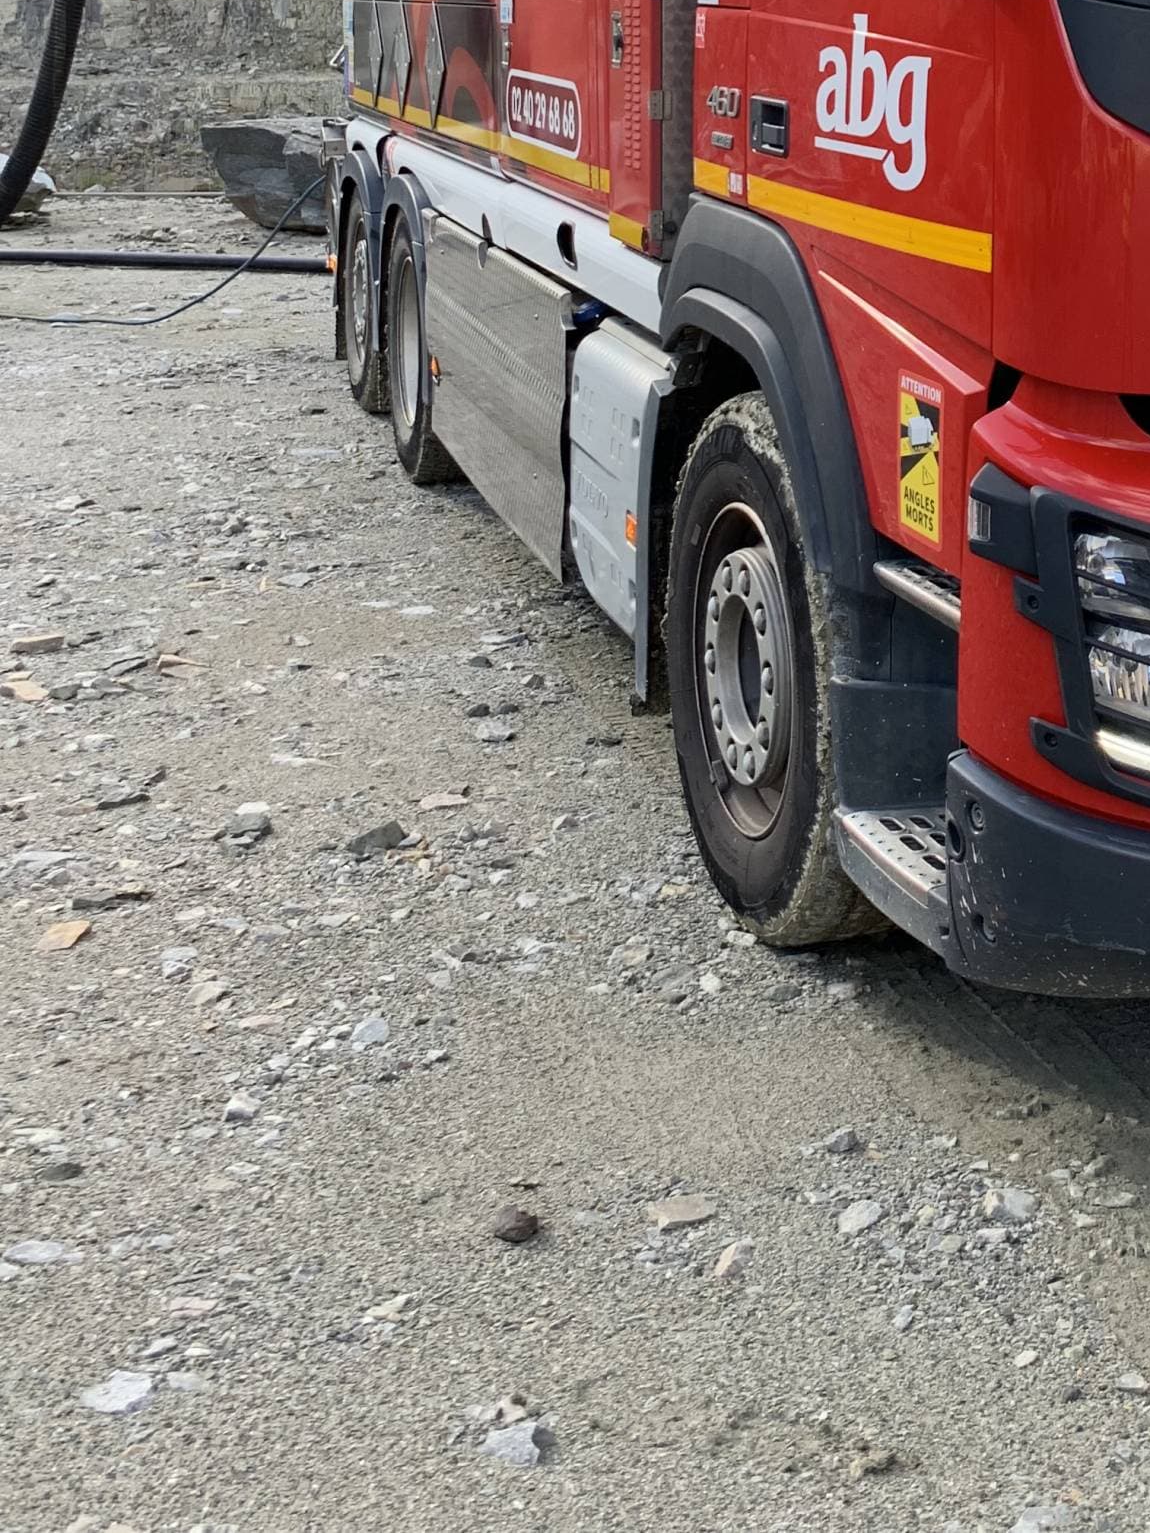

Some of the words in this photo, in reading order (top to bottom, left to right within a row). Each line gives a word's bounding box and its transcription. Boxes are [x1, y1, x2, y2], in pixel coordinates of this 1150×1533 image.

[512, 86, 521, 122] 02
[523, 88, 533, 126] 40
[535, 91, 546, 129] 29
[549, 96, 560, 135] 68
[563, 99, 575, 140] 68
[706, 85, 741, 117] 460
[815, 13, 932, 192] abg
[901, 375, 942, 404] ATTENTION
[904, 486, 935, 515] ANGLES
[905, 504, 934, 532] MORTS
